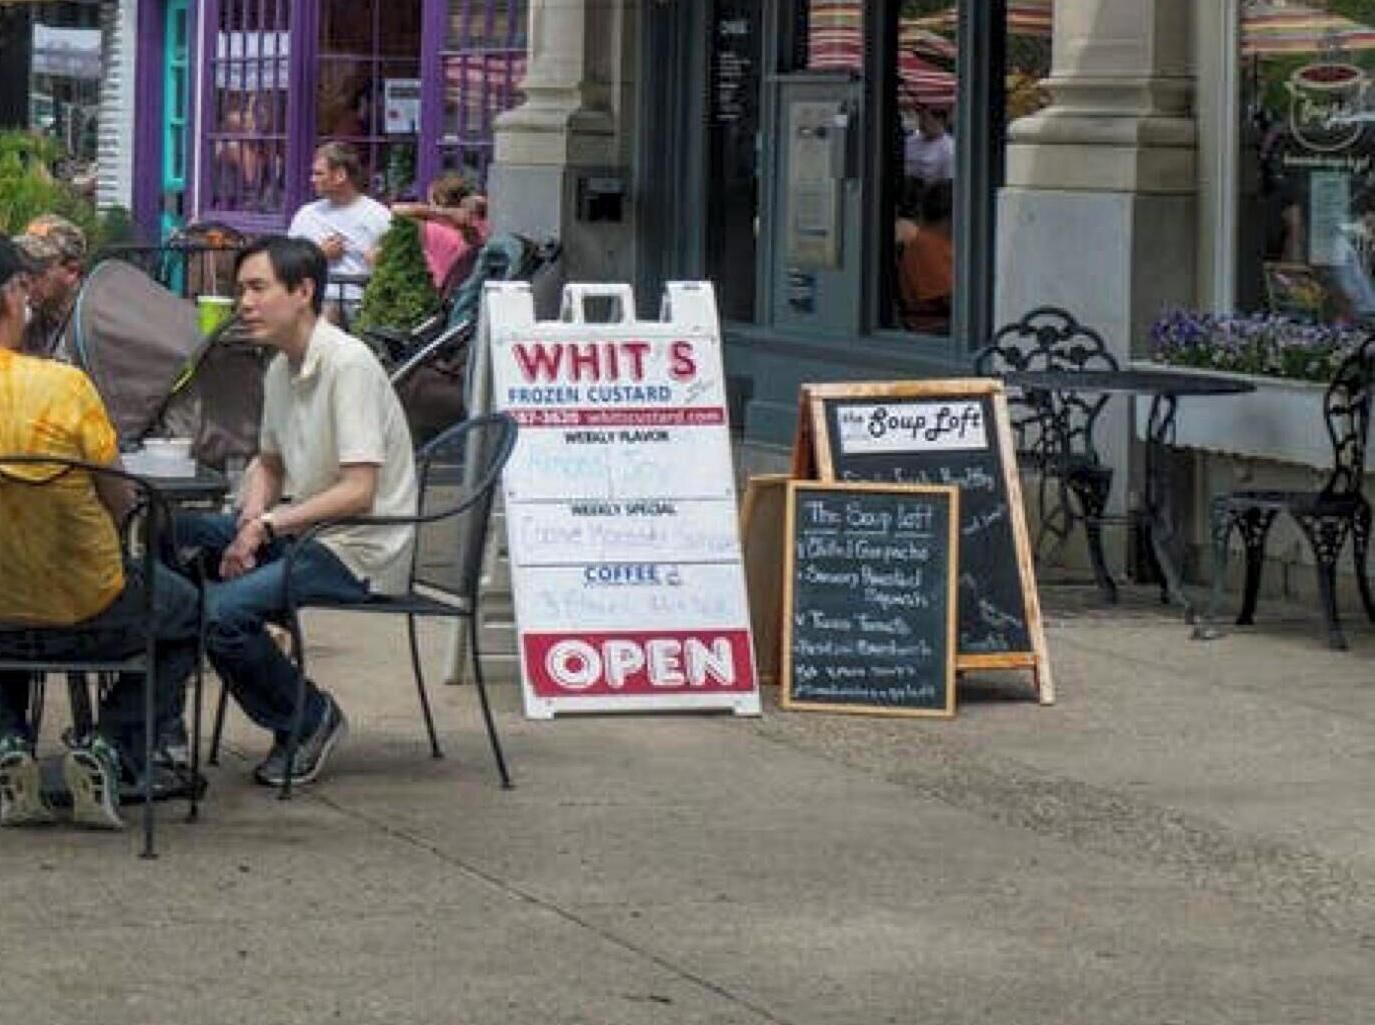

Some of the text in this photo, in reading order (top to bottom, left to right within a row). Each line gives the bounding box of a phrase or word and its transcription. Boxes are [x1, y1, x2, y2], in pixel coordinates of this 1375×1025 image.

[508, 386, 579, 404] FROZEN
[587, 385, 672, 403] CUSTARD
[843, 406, 981, 442] the Soup Loft
[565, 430, 670, 444] WEEKLY FLAVOR
[570, 502, 678, 517] WEEKLY SPECIAL
[802, 499, 843, 524] The
[846, 497, 892, 534] Soup
[896, 502, 933, 529] Loft
[584, 565, 658, 583] COFFEE
[545, 637, 735, 689] OPEN
